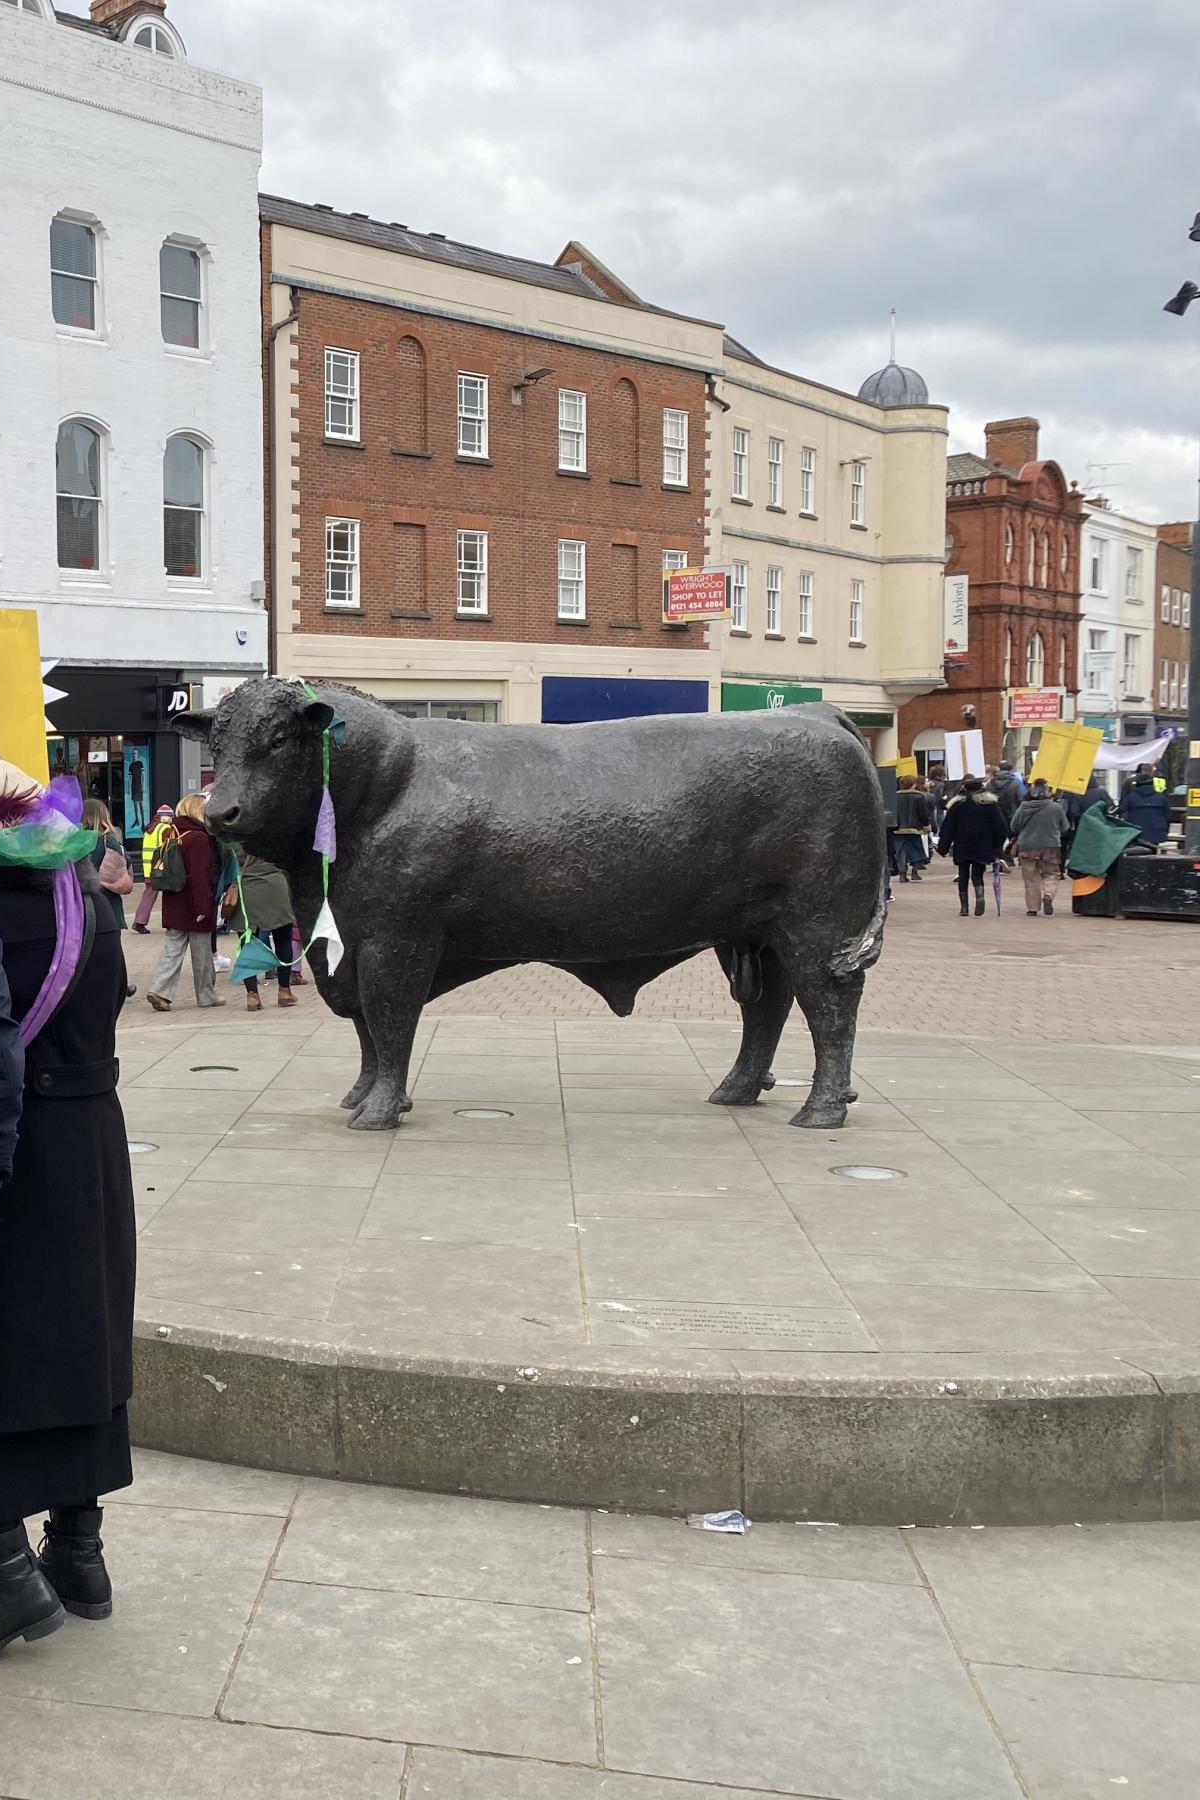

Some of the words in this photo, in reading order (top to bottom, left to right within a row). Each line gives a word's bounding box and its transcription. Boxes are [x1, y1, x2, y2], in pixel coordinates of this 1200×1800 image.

[680, 574, 715, 584] WRIGHT
[671, 581, 724, 591] SILVERWOOD
[672, 592, 693, 601] SHOP
[696, 592, 707, 600] TO
[708, 591, 723, 599] LET
[952, 582, 966, 626] Maylord
[167, 690, 189, 712] JD
